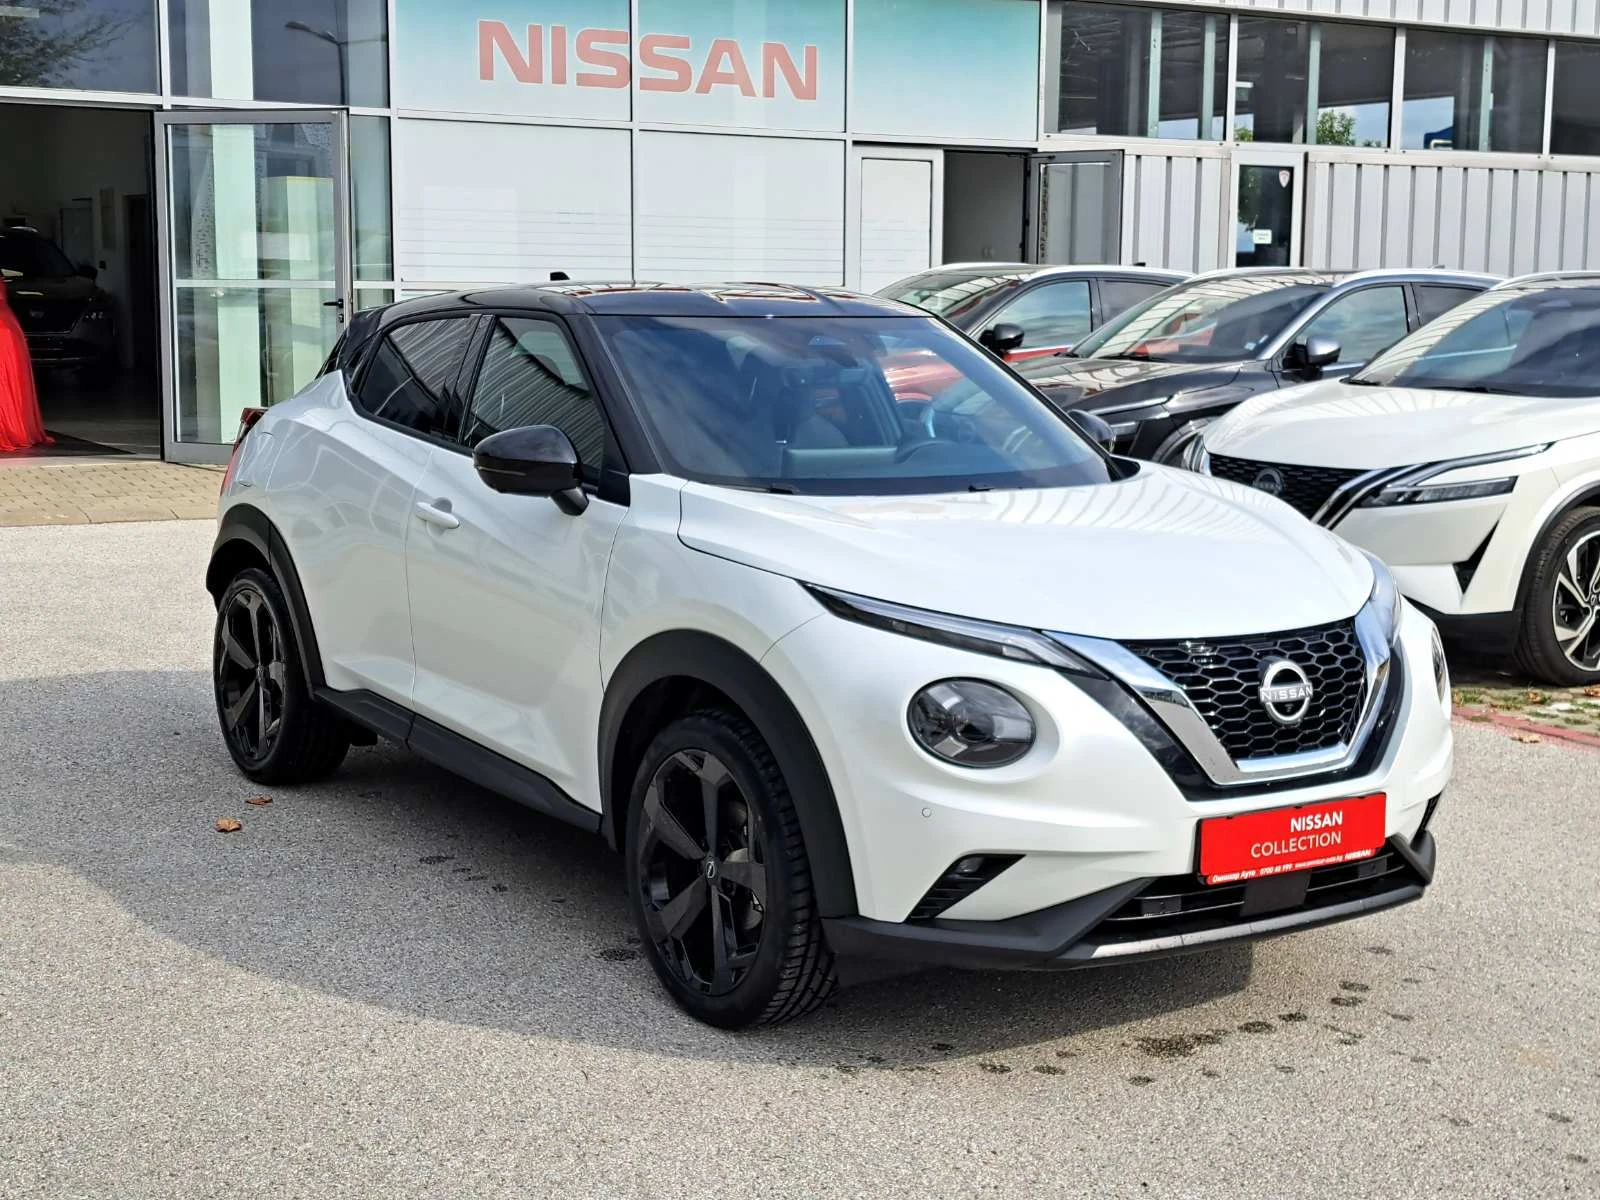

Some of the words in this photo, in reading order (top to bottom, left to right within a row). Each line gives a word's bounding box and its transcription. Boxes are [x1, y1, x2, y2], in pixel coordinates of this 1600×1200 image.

[478, 19, 818, 101] NISSAN
[1261, 683, 1313, 702] NISSAN
[1290, 811, 1343, 833] NISSAN
[1250, 830, 1342, 858] COLLECTION
